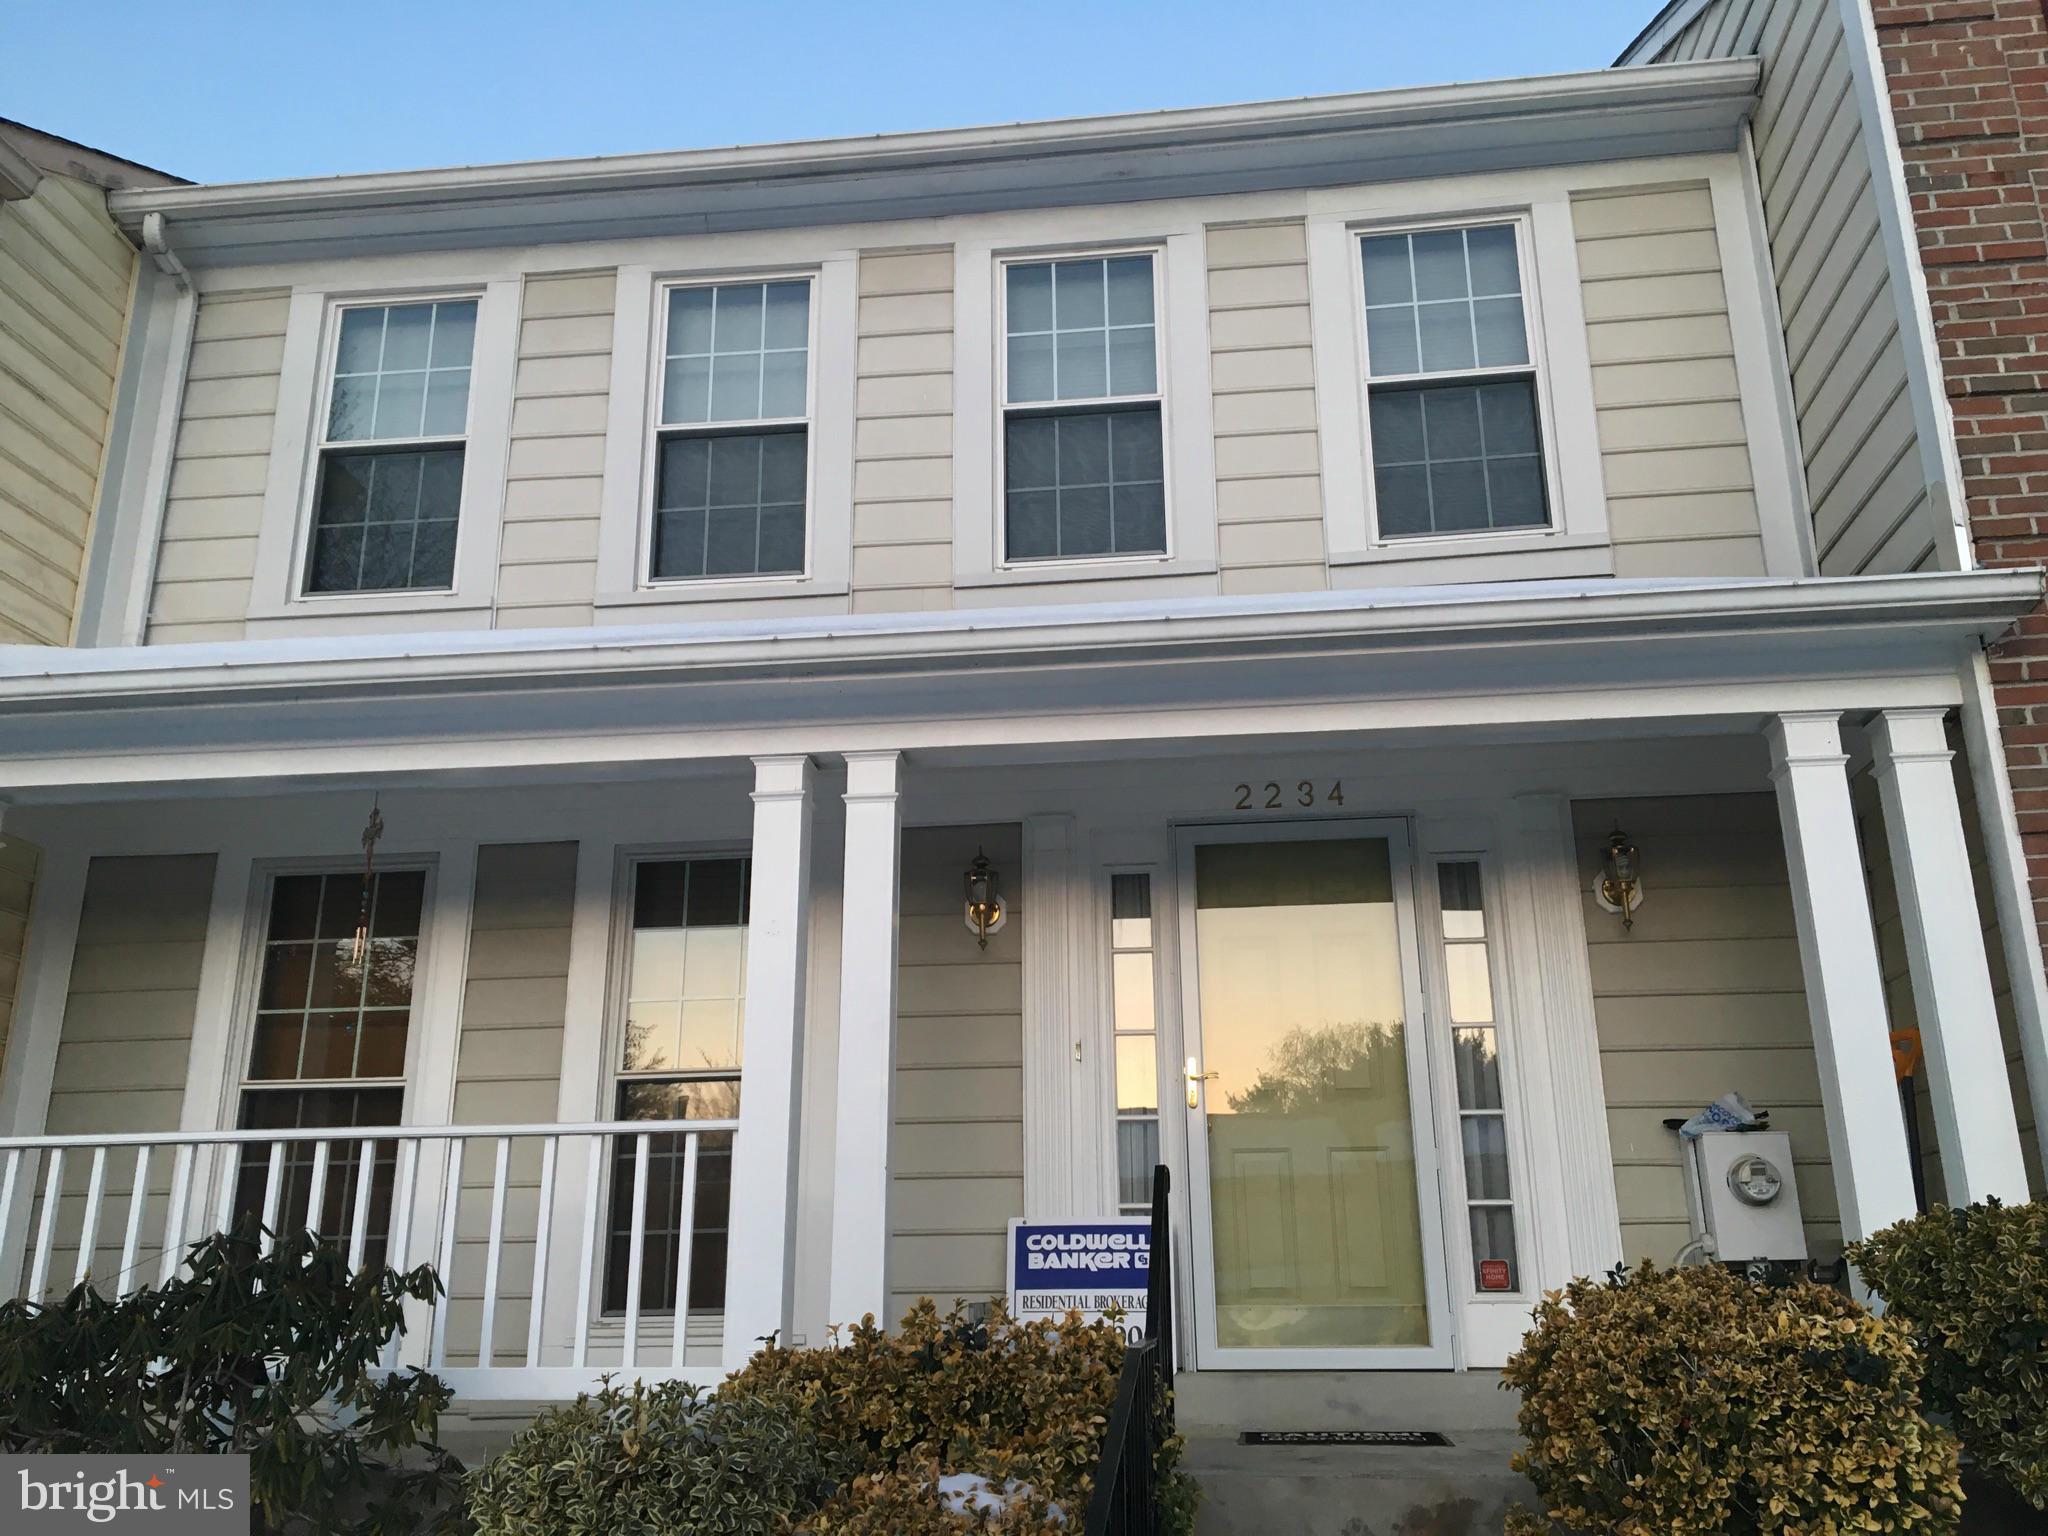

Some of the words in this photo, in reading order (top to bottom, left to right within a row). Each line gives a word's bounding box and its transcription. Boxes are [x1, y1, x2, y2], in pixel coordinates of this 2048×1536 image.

[1234, 780, 1344, 809] 2234
[1028, 1252, 1131, 1272] BANKER
[1022, 1295, 1091, 1309] RESIDENTIAL
[1094, 1294, 1148, 1309] BROKERAG
